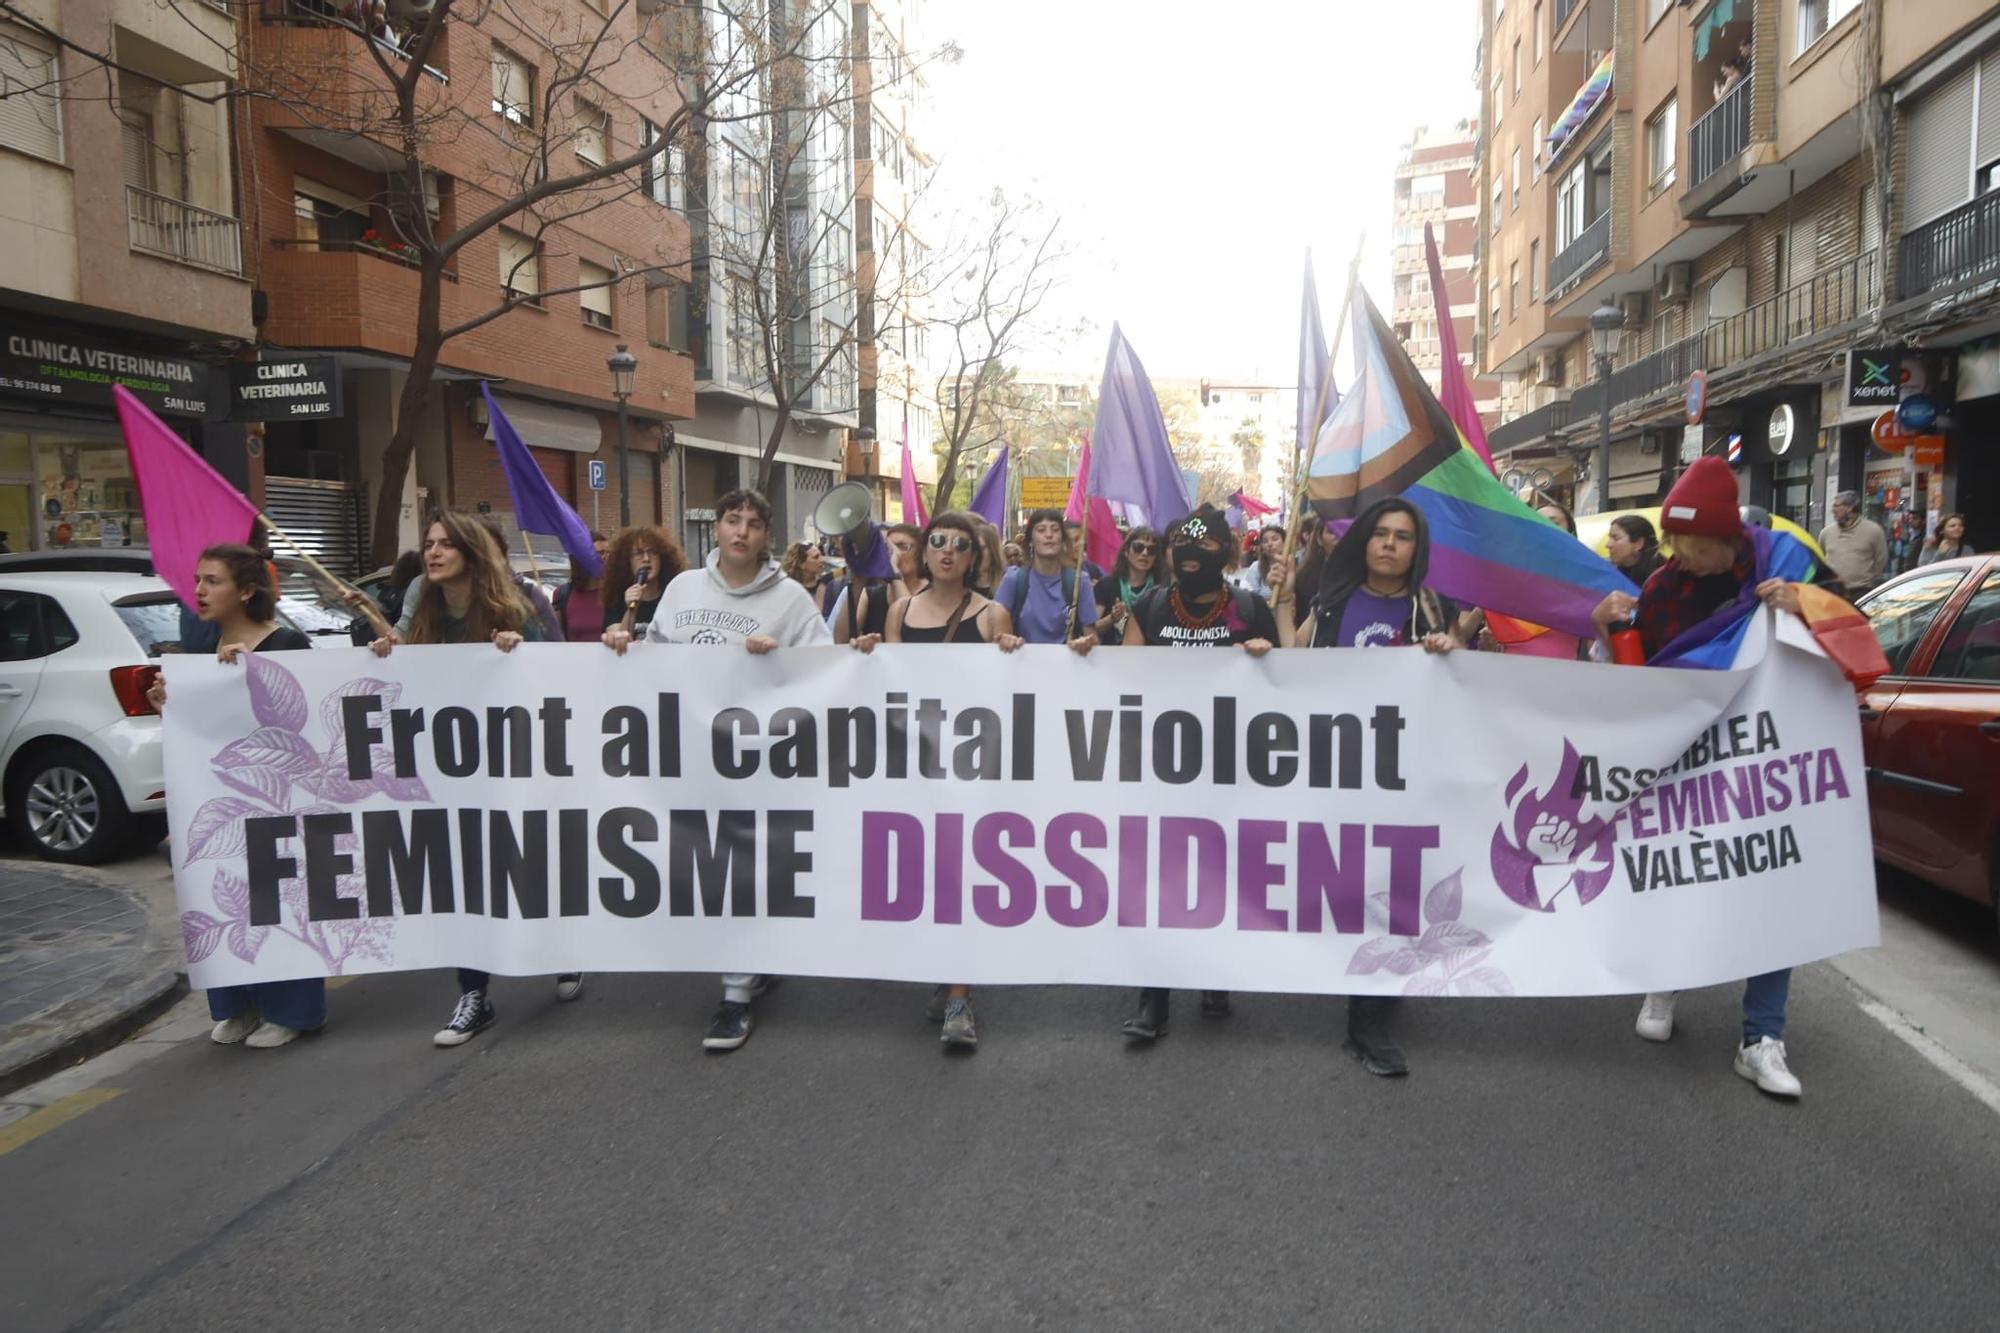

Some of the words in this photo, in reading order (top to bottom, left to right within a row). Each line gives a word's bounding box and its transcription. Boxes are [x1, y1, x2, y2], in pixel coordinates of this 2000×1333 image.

[8, 335, 82, 365] CLINICA
[84, 348, 193, 382] VETERINARIA
[257, 363, 308, 380] CLINICA
[240, 381, 327, 400] VETERINARIA
[1853, 384, 1898, 398] xenet
[164, 397, 184, 410] SAN
[185, 400, 206, 413] LUIS
[290, 403, 309, 414] SAN
[311, 402, 331, 413] LUIS
[594, 465, 602, 486] P
[1159, 625, 1231, 640] ABOLICIONISTA
[341, 694, 574, 781] Front
[601, 692, 681, 778] al
[711, 692, 1036, 788] capital
[1064, 694, 1406, 791] violent
[1620, 824, 1802, 893] VALÈNCIA
[245, 806, 816, 927] FEMINISME
[861, 810, 1441, 937] DISSIDENT
